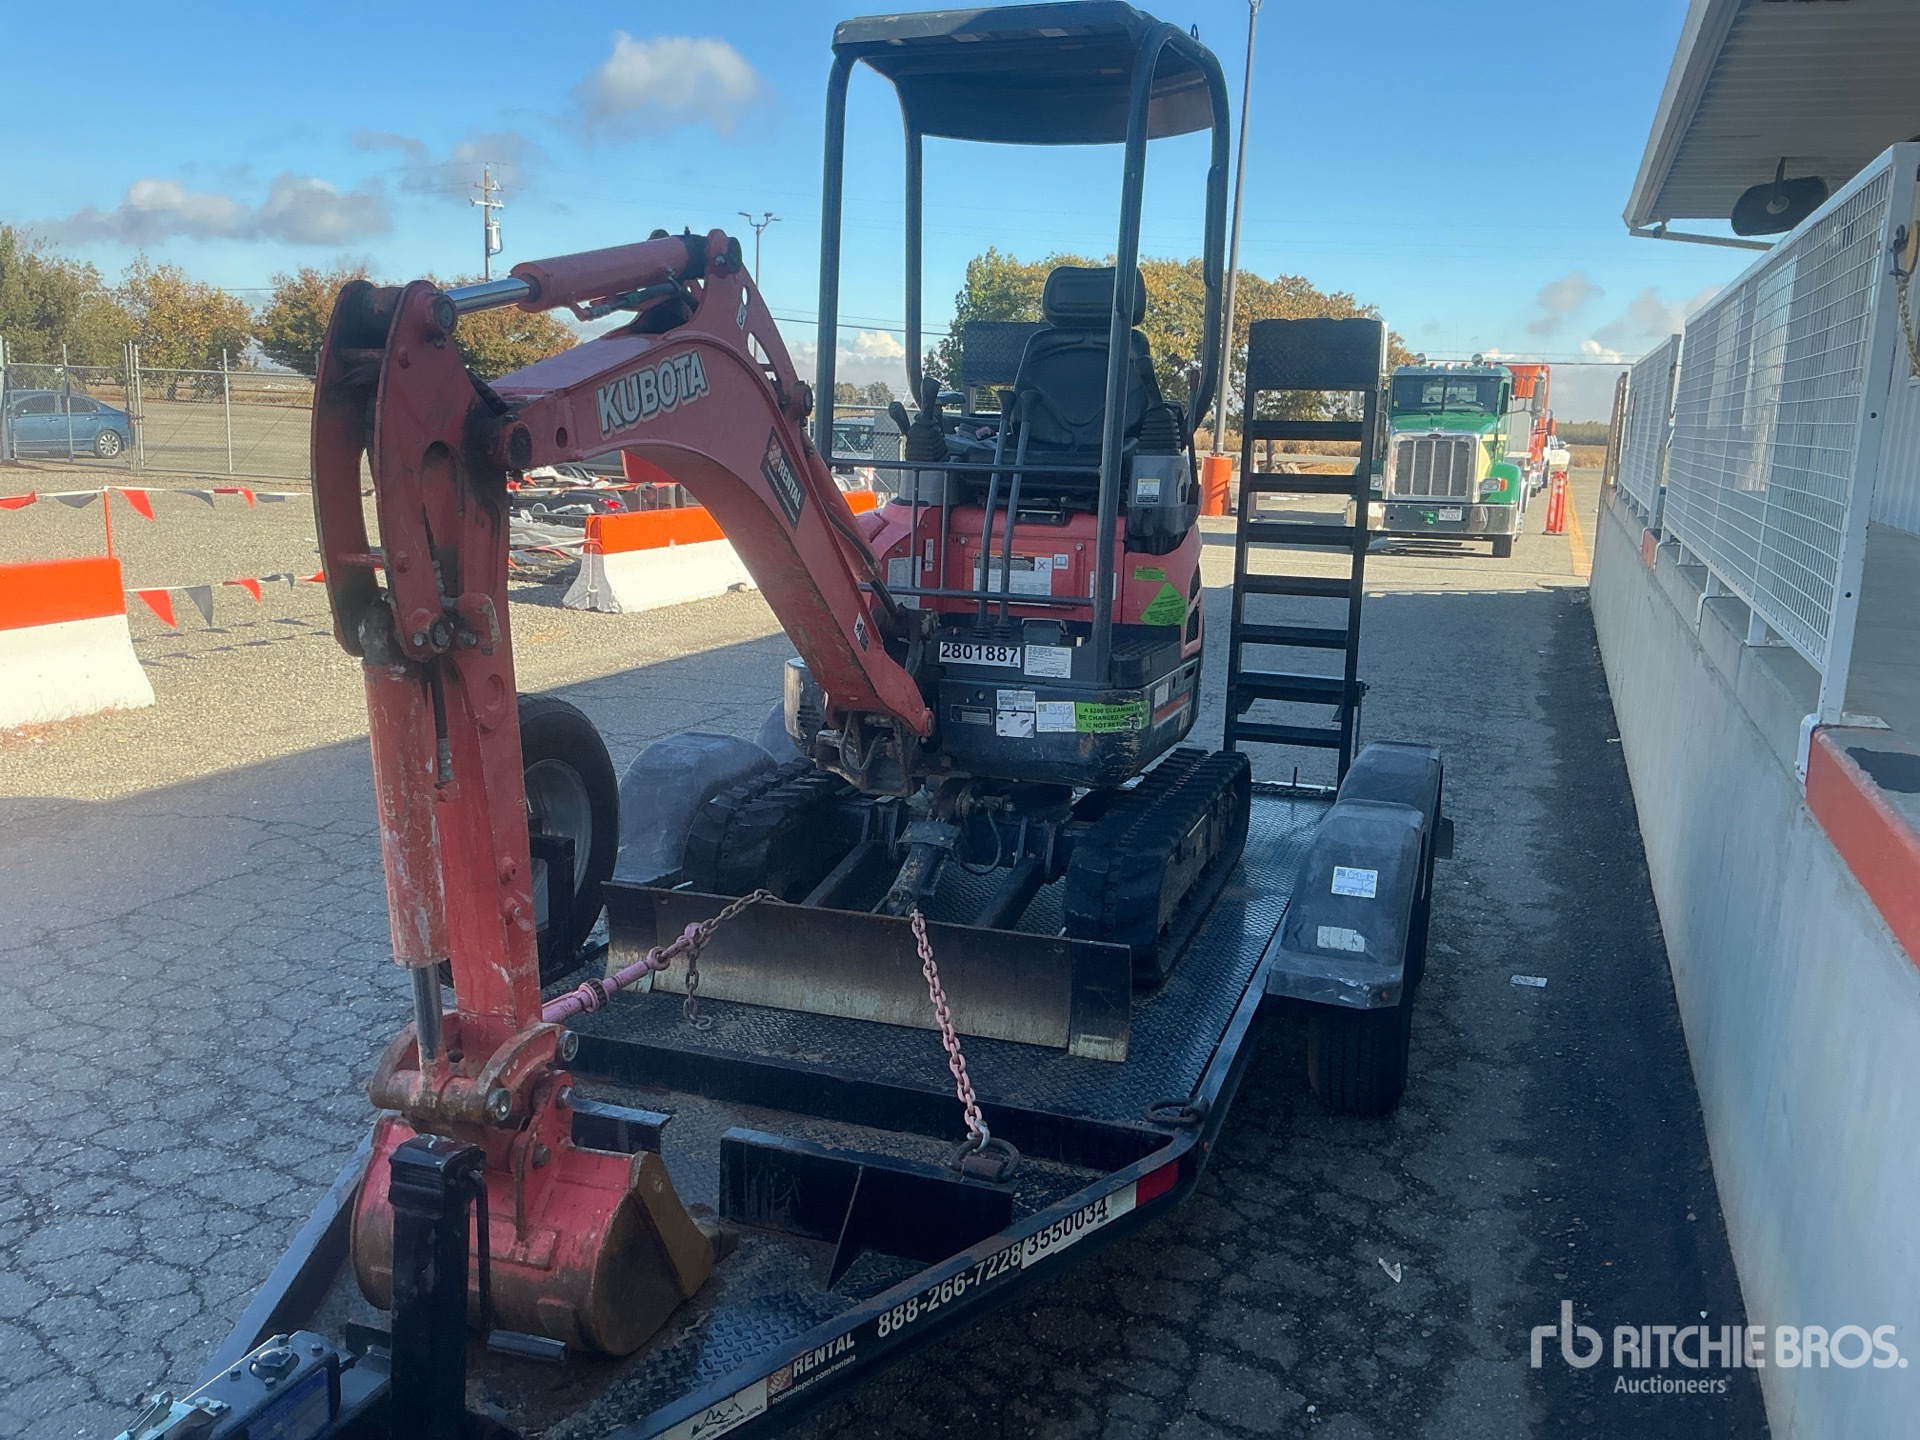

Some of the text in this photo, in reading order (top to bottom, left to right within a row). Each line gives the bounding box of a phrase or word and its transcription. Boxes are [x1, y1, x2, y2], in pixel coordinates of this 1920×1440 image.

[596, 350, 708, 435] KUBOTA
[778, 458, 801, 510] RENTAL
[941, 643, 1018, 662] 2801887
[1027, 1196, 1107, 1256] 3550034
[877, 1242, 1022, 1338] 888-266-7228
[772, 1354, 856, 1404] homedepot.com/rentals
[793, 1332, 855, 1378] RENTAL
